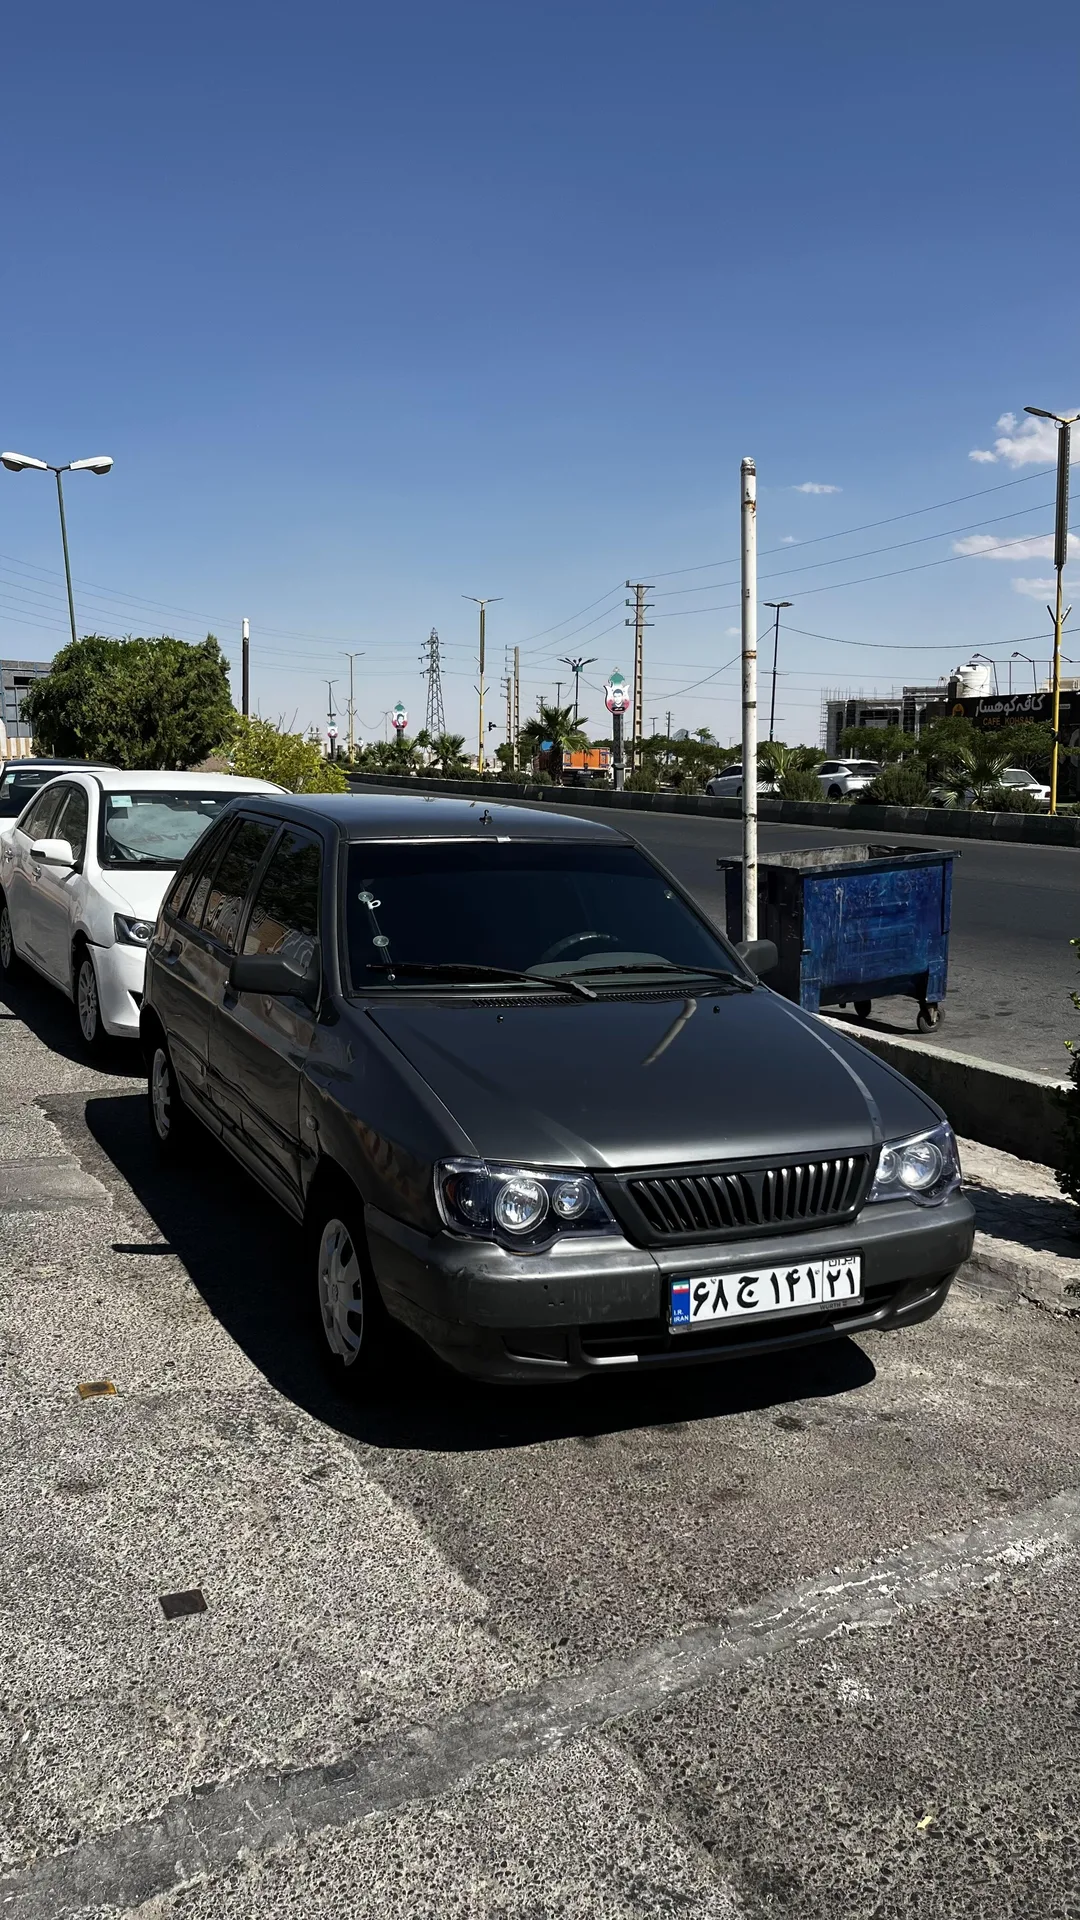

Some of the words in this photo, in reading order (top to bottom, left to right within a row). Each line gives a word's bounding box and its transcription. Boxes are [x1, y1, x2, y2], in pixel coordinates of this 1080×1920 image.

[975, 695, 1018, 716] کوهسار
[1017, 694, 1045, 711] کافه
[983, 717, 1001, 726] CAFE
